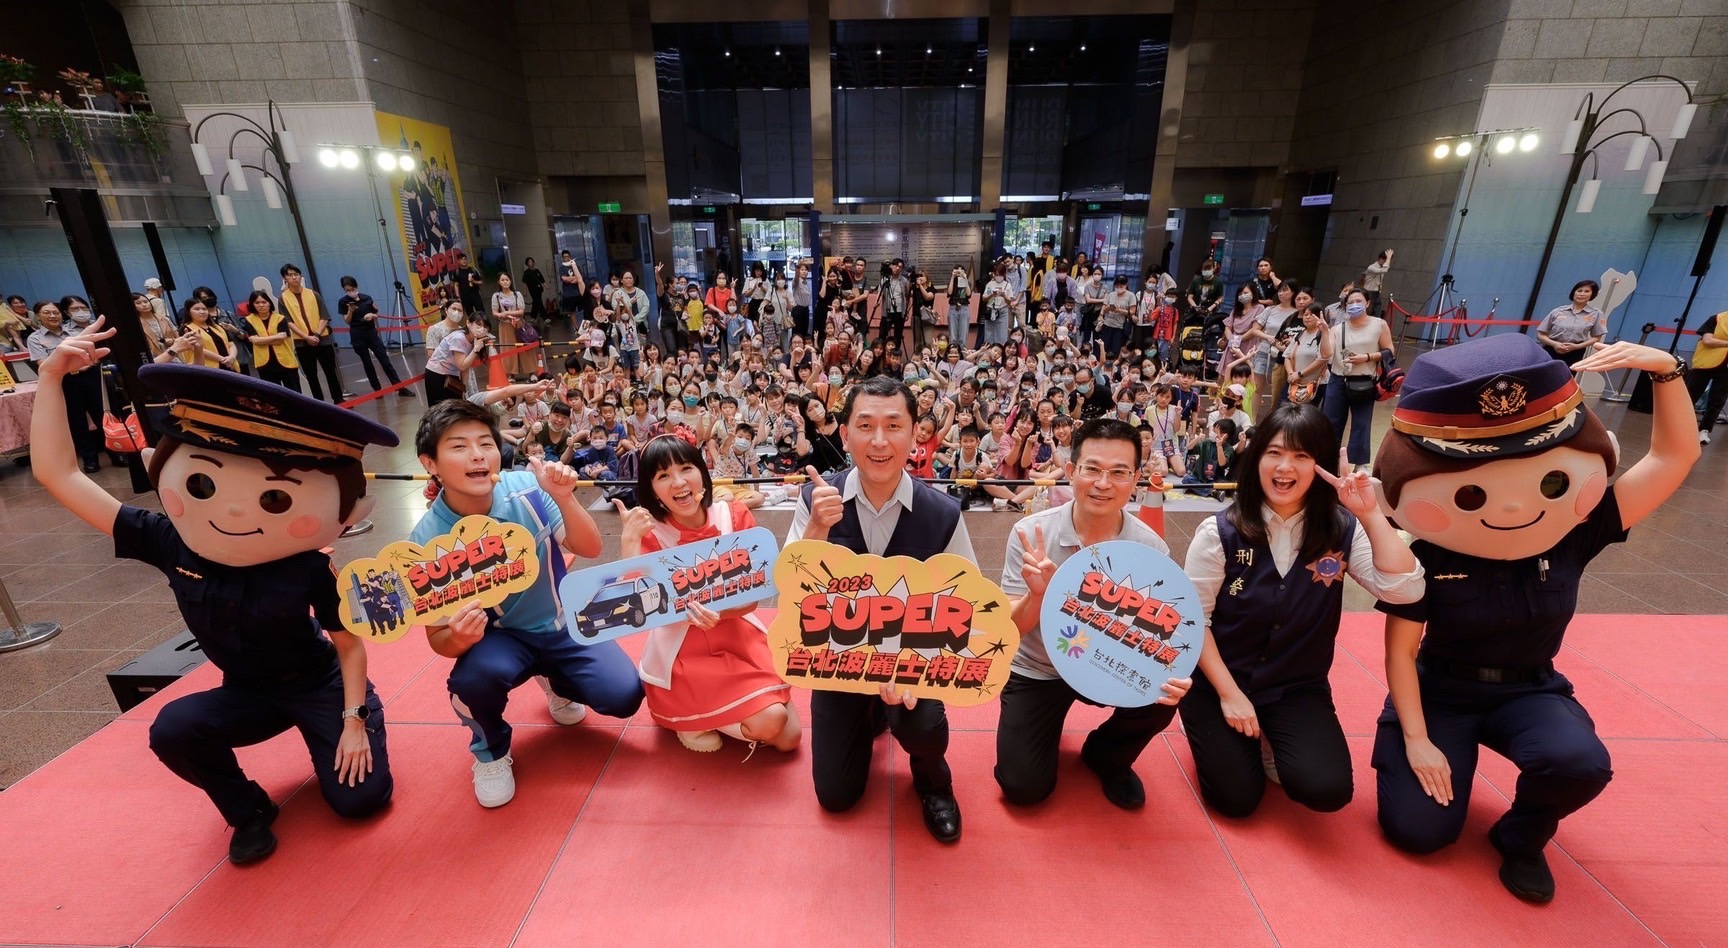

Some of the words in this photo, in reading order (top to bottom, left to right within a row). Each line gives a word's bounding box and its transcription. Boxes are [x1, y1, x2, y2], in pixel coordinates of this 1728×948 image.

[408, 535, 507, 594] SUPER
[414, 559, 526, 615] 台北波麗士特展
[671, 549, 751, 595] SUPER
[674, 570, 766, 613] 台北波麗士特展
[828, 574, 873, 593] 2023
[800, 592, 974, 650] SUPER
[1060, 598, 1181, 665] 台北波麗士特展
[1078, 571, 1182, 641] SUPER
[786, 647, 993, 687] 台北波麗士特展
